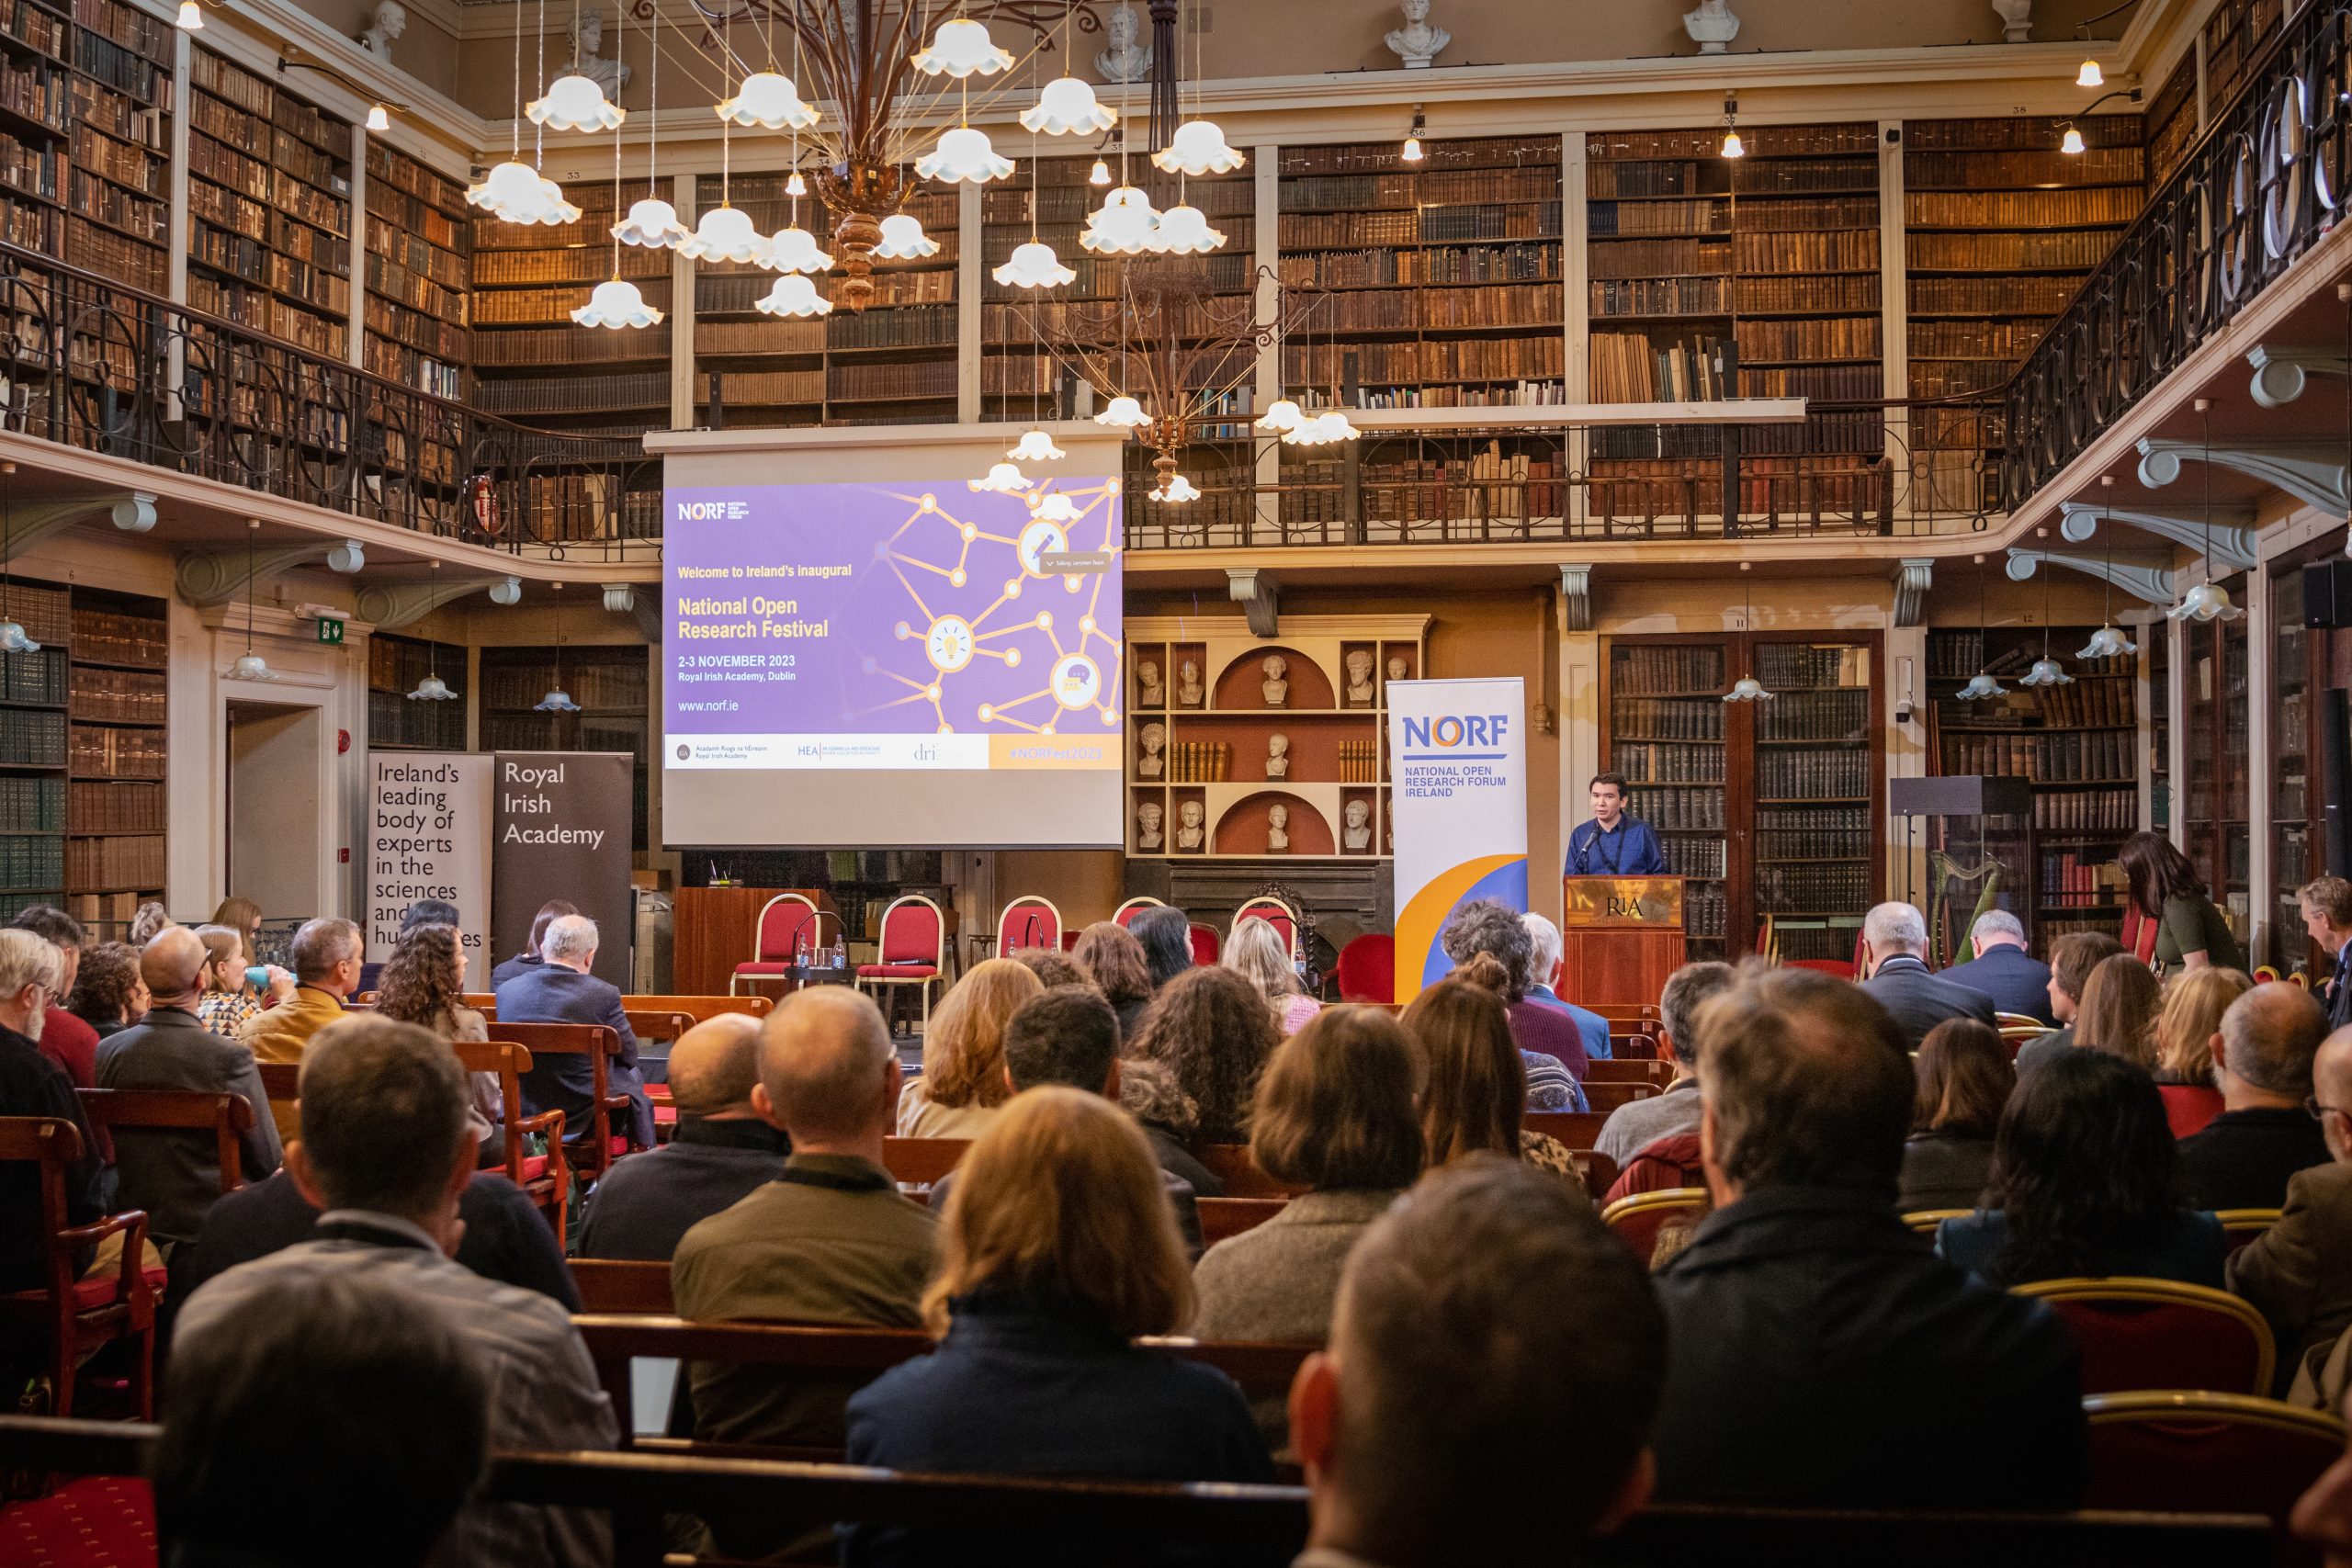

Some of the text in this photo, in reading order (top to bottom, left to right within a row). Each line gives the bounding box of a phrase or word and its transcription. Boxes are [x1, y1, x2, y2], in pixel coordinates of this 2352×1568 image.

[2013, 106, 2027, 115] 38
[567, 171, 581, 180] 33
[677, 502, 726, 521] NORF
[69, 570, 74, 581] 6
[678, 563, 852, 580] Welcome to Ireland's inaugural
[678, 595, 797, 618] National Open
[678, 619, 829, 639] Research Festival
[678, 654, 796, 668] 2-3 NOVEMBER 2023
[678, 671, 797, 682] Royal Irish Academy, Dublin
[678, 699, 739, 711] www.norf.ie
[1402, 715, 1509, 748] NORF
[797, 745, 819, 756] HEA
[1010, 746, 1102, 761] #NORFest2023
[505, 762, 564, 788] Royal
[1405, 765, 1492, 776] NATIONAL OPEN
[1405, 776, 1506, 787] RESEARCH FORUM
[378, 785, 447, 811] leading
[1405, 787, 1453, 797] IRELAND
[504, 793, 551, 813] Irish
[377, 809, 456, 834] body of
[503, 823, 605, 850] Academy
[376, 835, 452, 857] experts
[376, 856, 434, 875] in the
[375, 881, 458, 899] sciences
[1607, 897, 1645, 917] RIA
